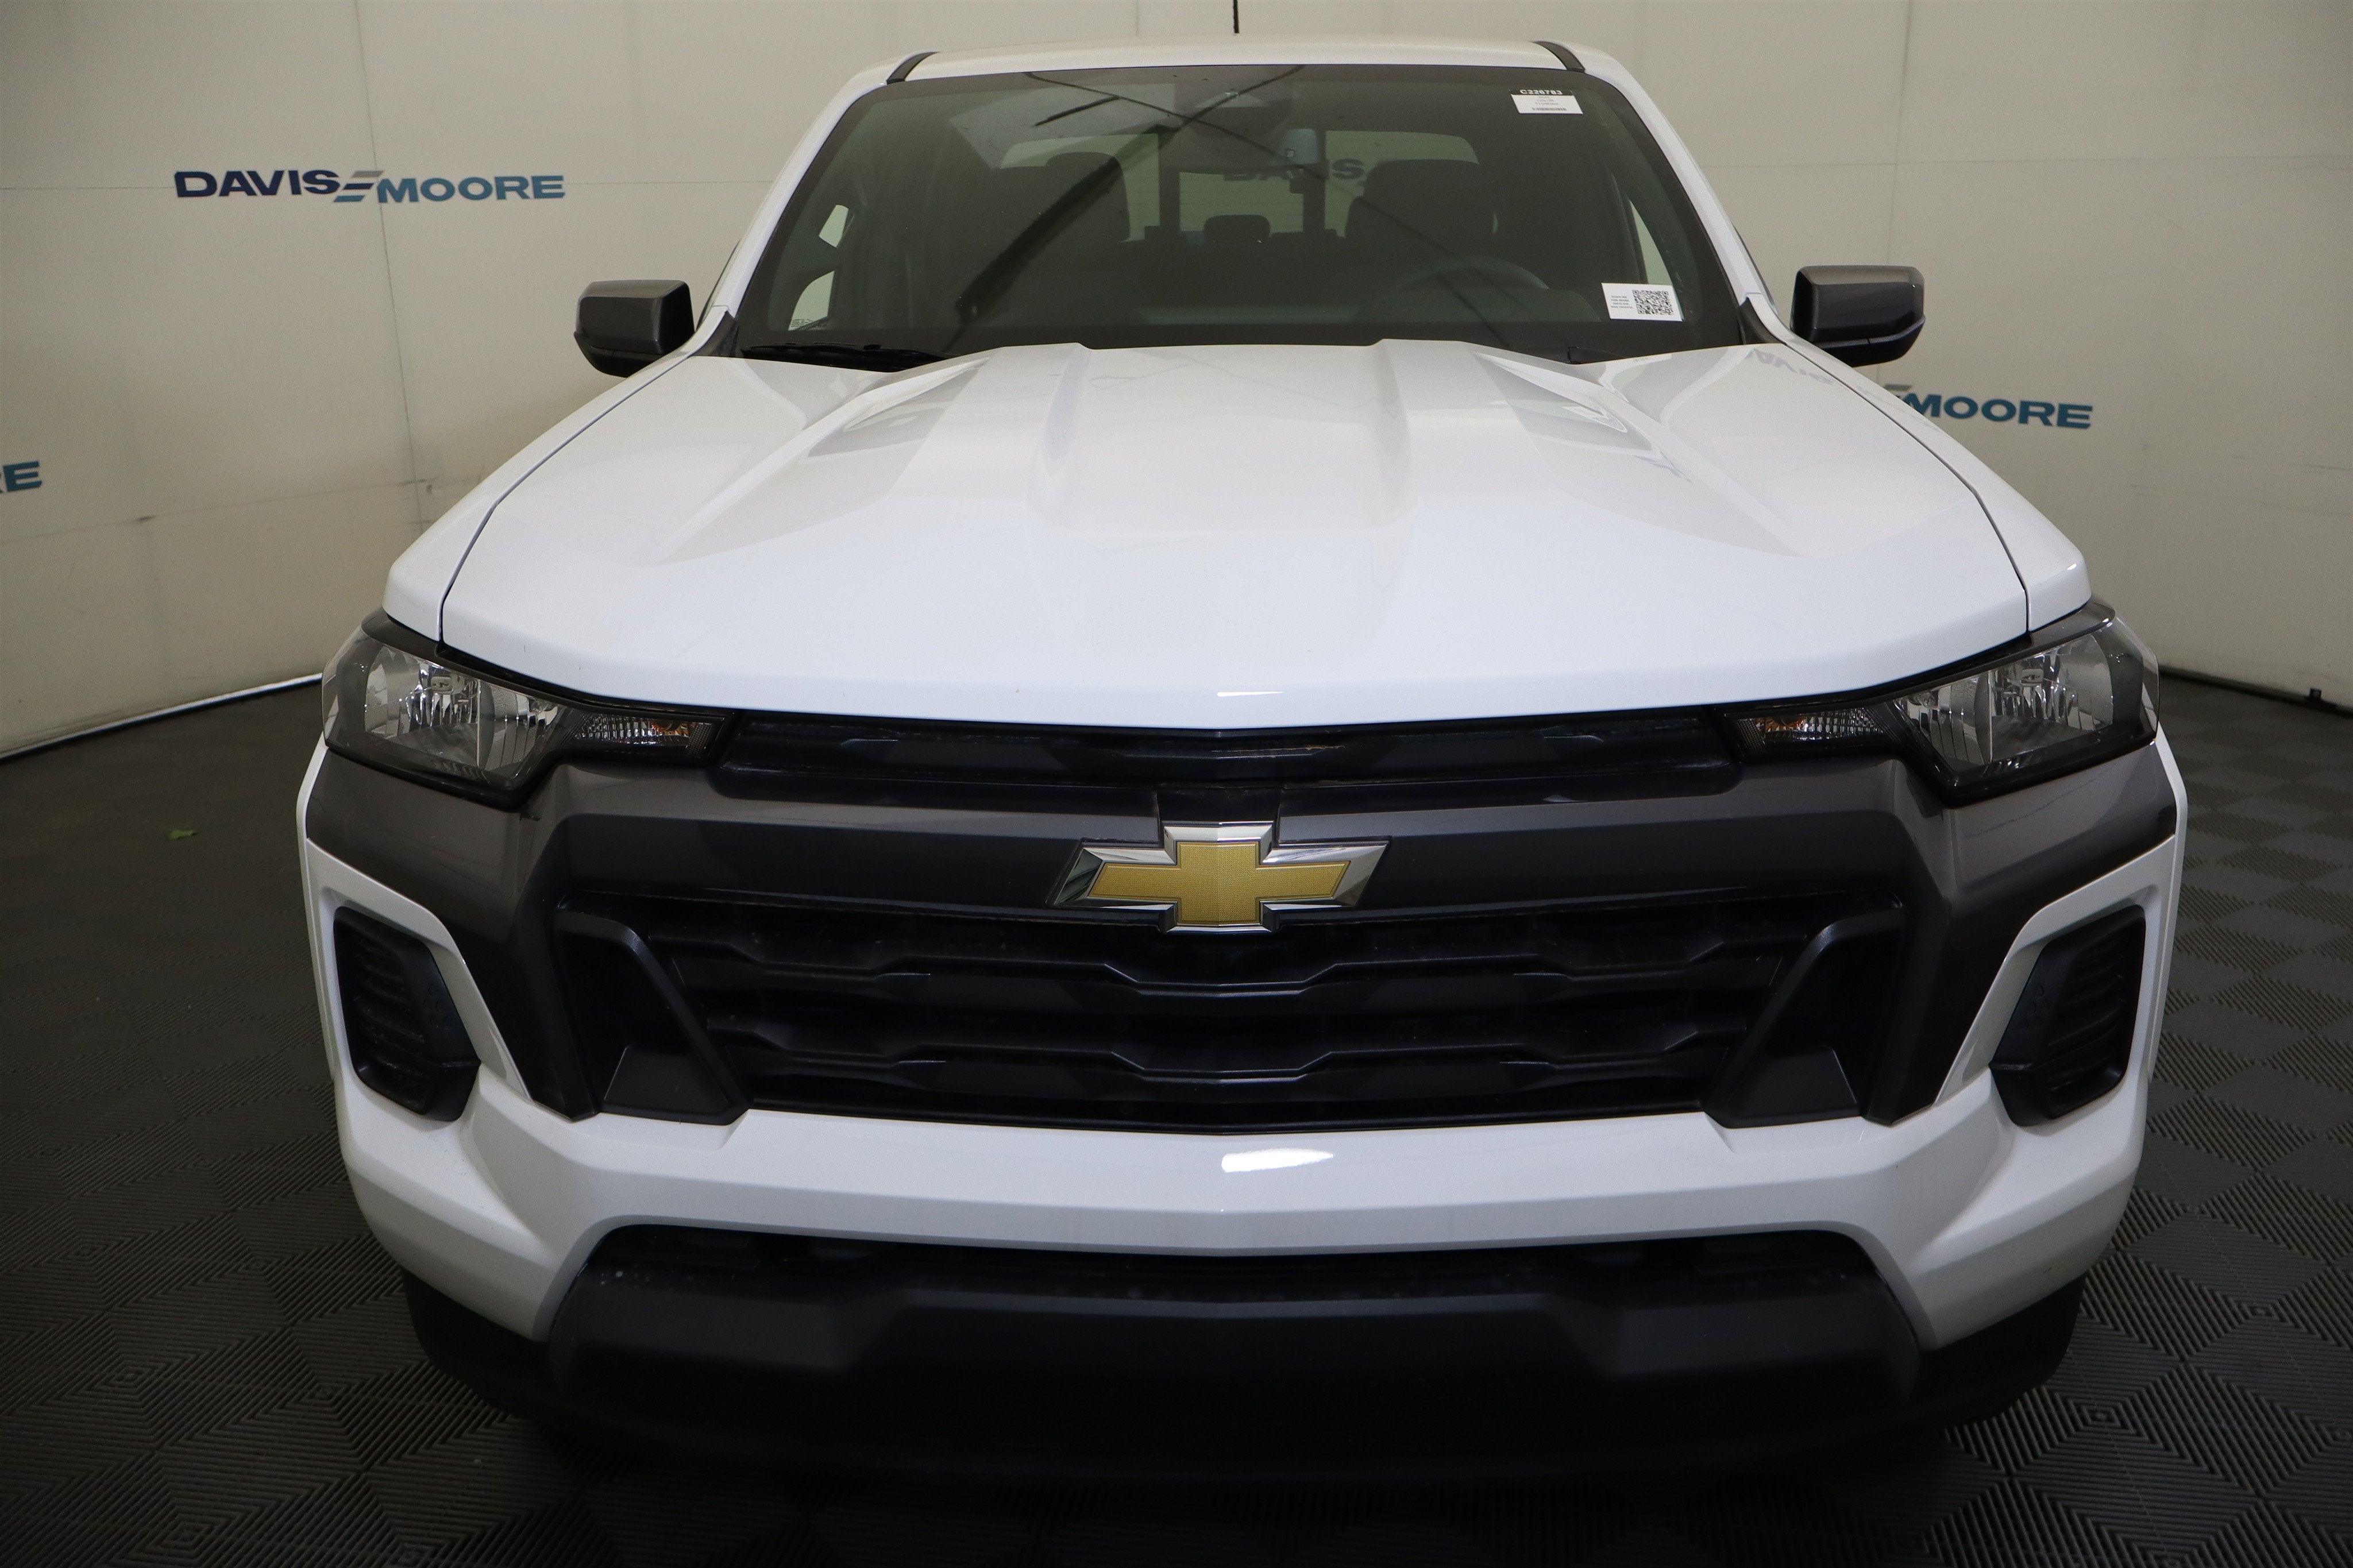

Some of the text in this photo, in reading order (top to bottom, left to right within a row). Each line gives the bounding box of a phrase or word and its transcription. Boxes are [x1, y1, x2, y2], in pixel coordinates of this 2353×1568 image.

[174, 169, 565, 203] DAVIS MOORE
[1903, 393, 2093, 429] MOORE
